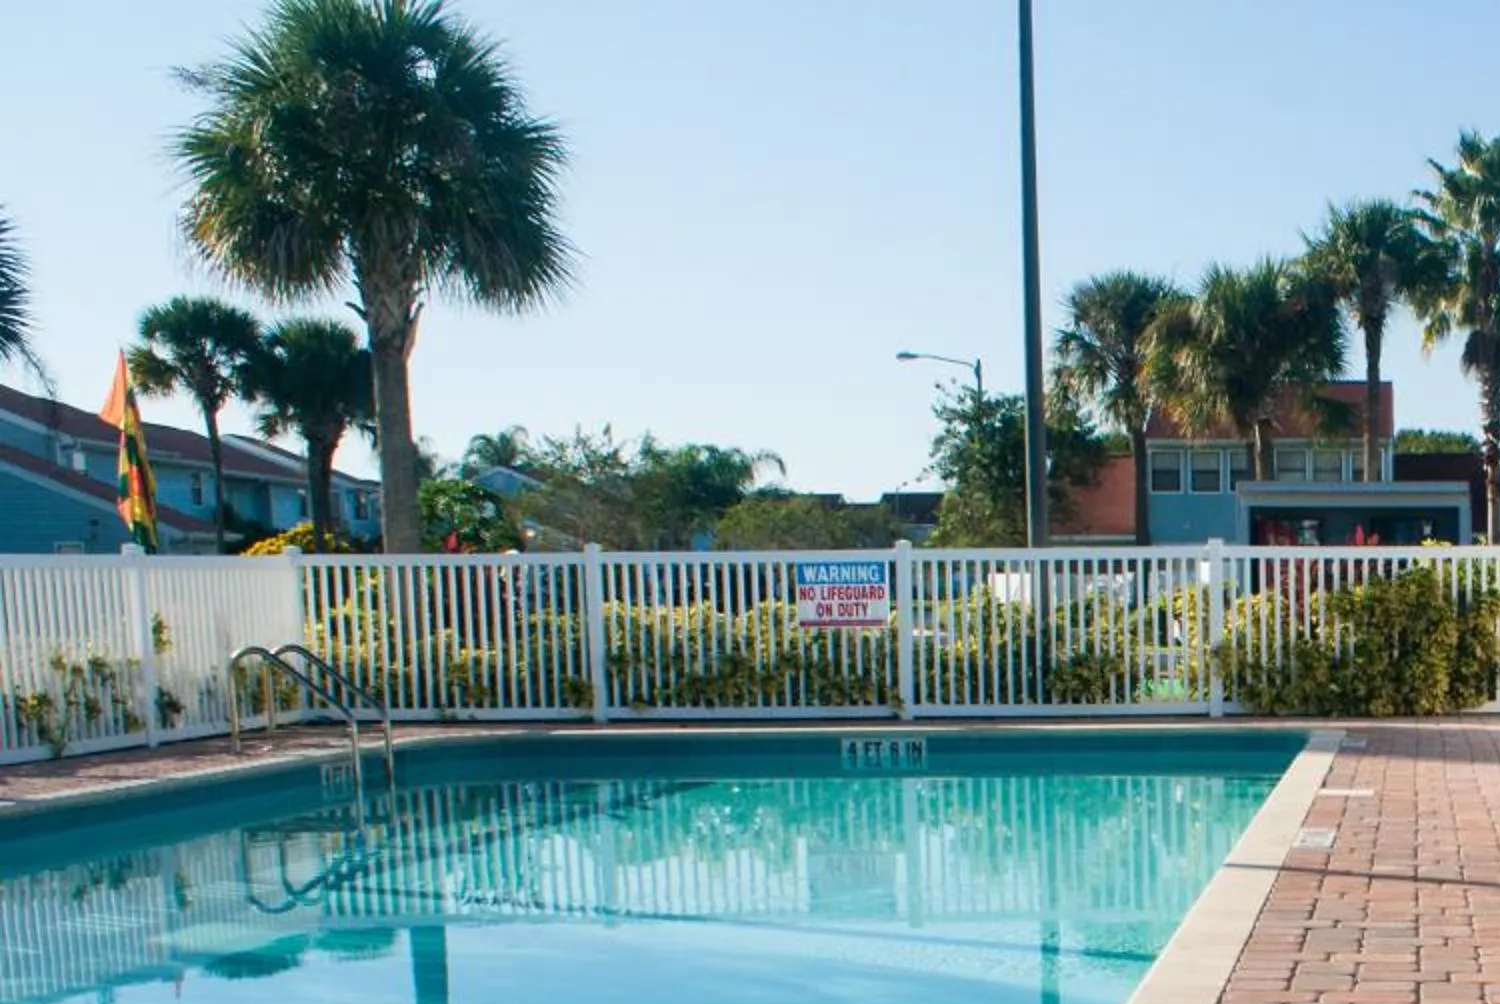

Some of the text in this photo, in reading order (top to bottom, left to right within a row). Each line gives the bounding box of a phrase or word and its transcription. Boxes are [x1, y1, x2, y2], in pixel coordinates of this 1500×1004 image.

[802, 564, 881, 583] WARNING
[799, 585, 885, 600] NO LIFEGUARD
[815, 602, 869, 617] ON DUTY
